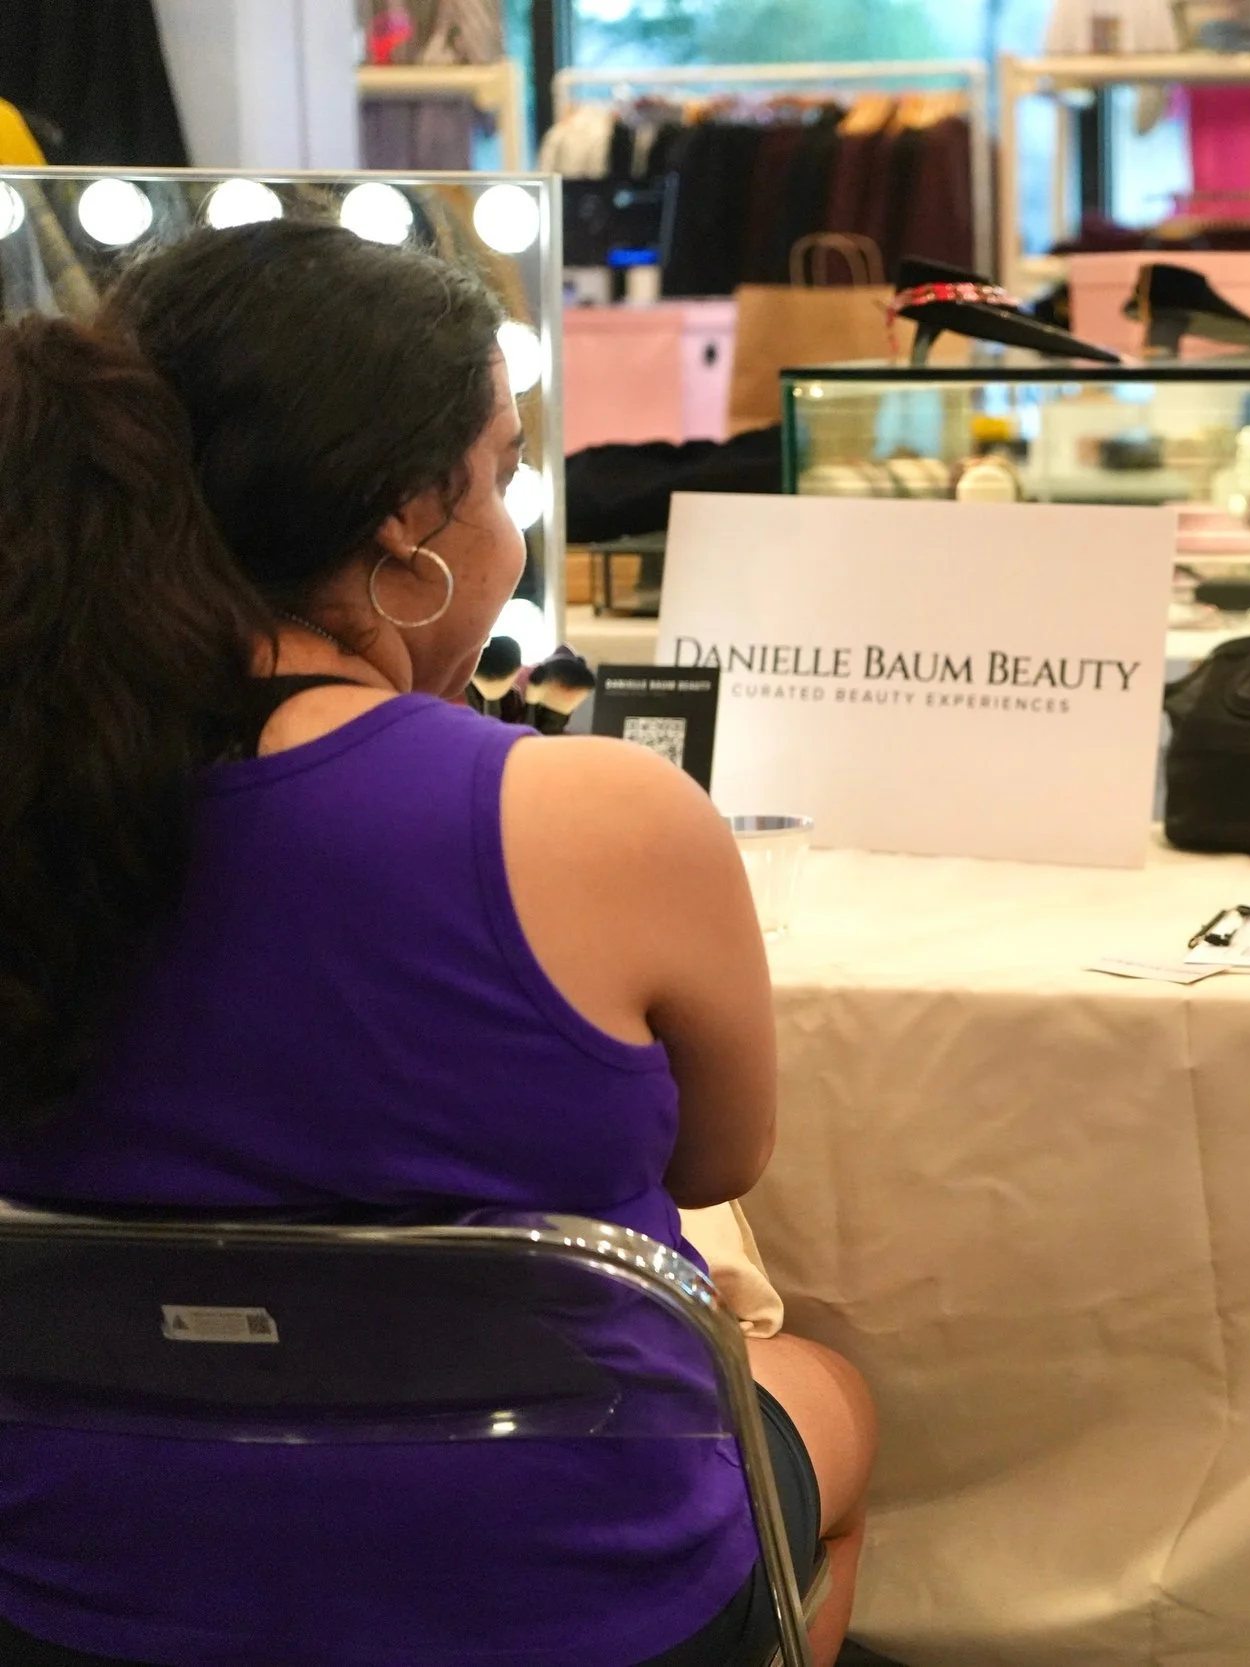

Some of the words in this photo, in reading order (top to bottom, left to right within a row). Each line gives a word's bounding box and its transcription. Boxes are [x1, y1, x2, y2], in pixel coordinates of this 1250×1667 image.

[674, 635, 851, 678] DANIELLE
[863, 644, 972, 685] BAUM
[987, 650, 1141, 691] BEAUTY
[731, 682, 825, 701] CURATED
[835, 687, 915, 705] BEAUTY
[926, 692, 1070, 713] EXPERIENCES
